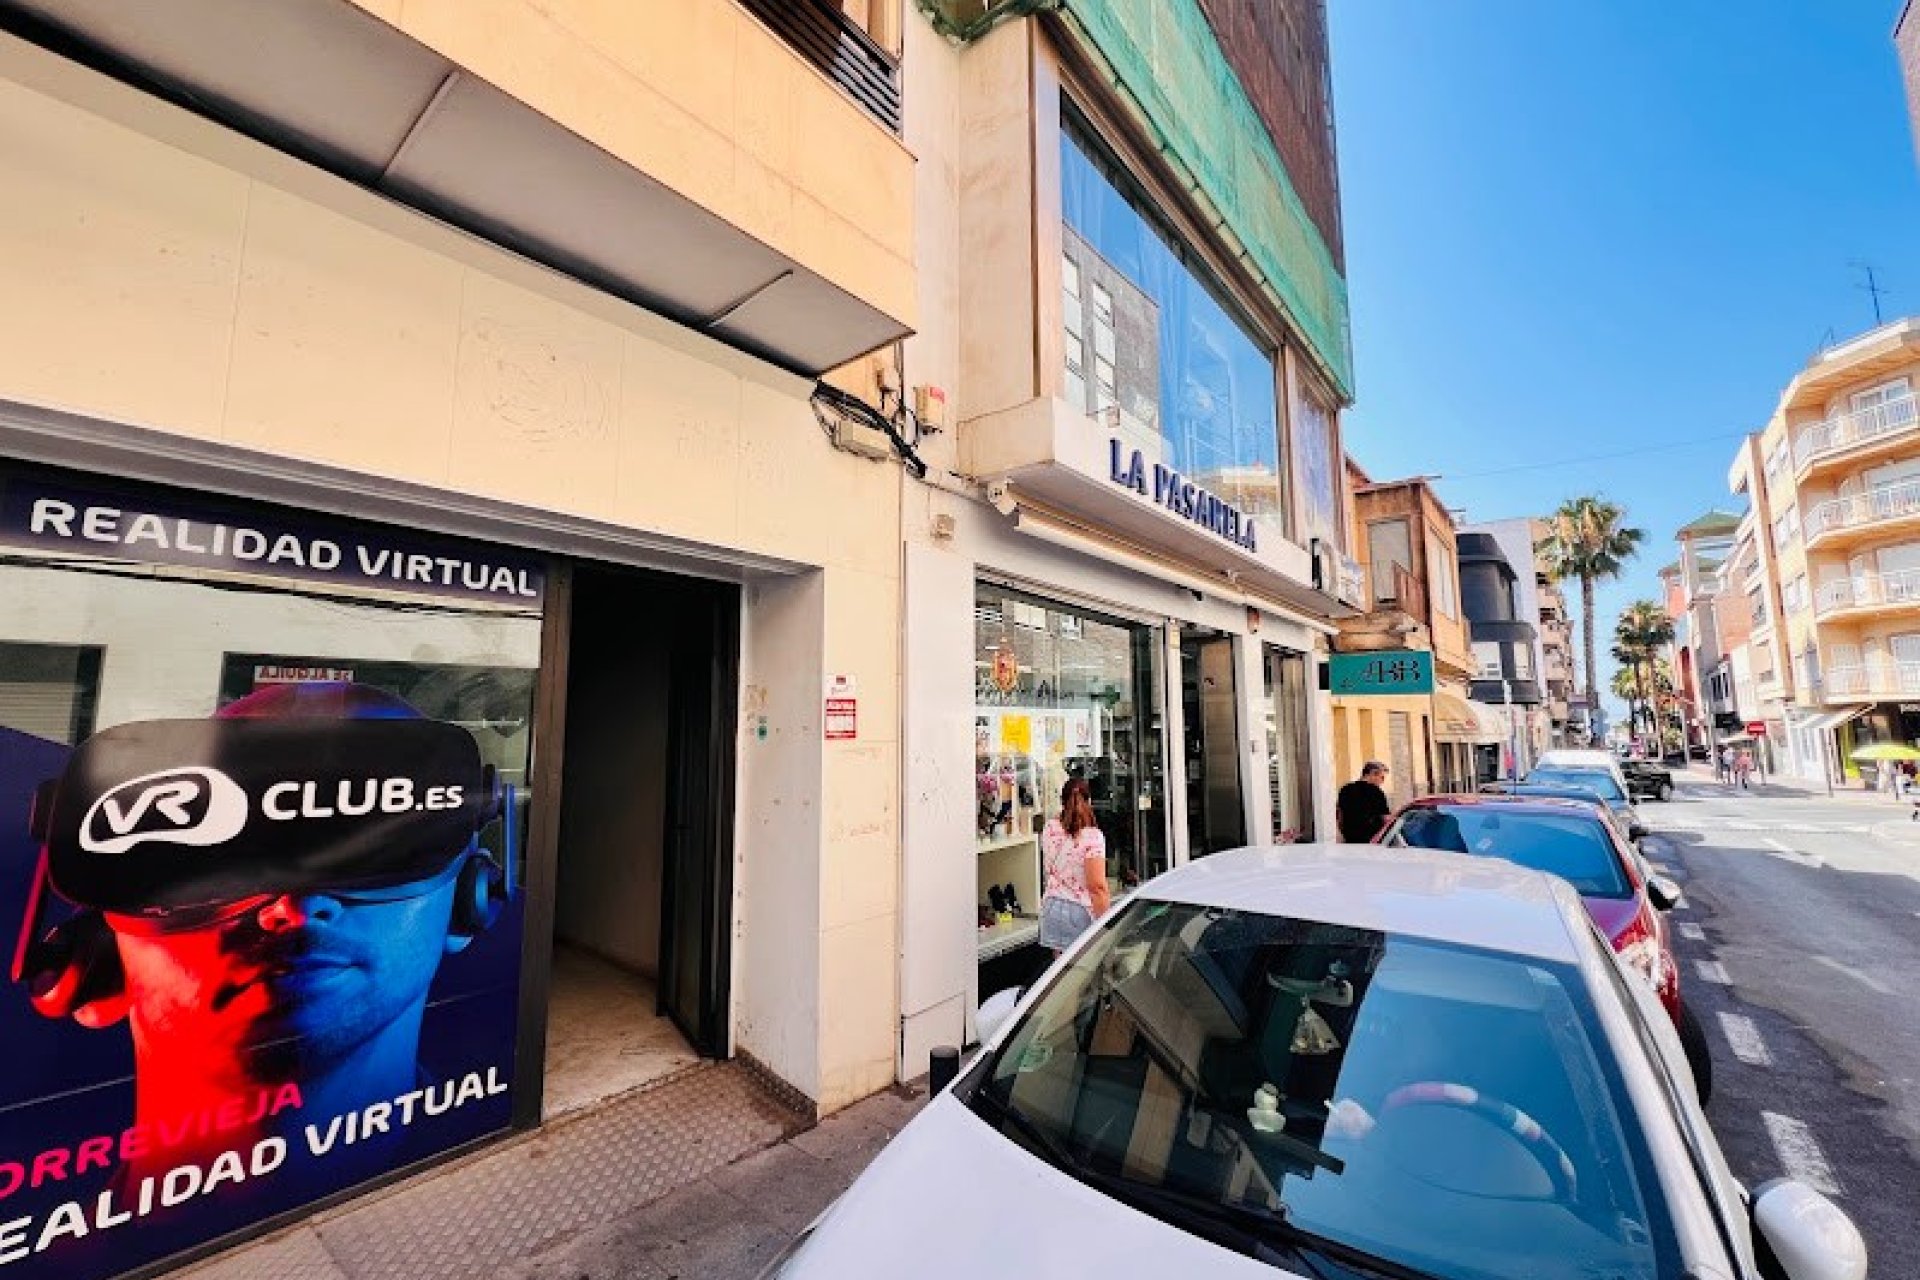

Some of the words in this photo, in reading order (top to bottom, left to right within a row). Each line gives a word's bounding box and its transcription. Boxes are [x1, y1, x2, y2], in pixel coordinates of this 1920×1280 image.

[1110, 438, 1147, 495] LA
[30, 497, 342, 571] REALIDAD
[356, 545, 537, 597] VIRTUAL
[103, 779, 200, 835] VR
[261, 776, 464, 821] CLUB.ES
[304, 1066, 508, 1157] VIRTUAL
